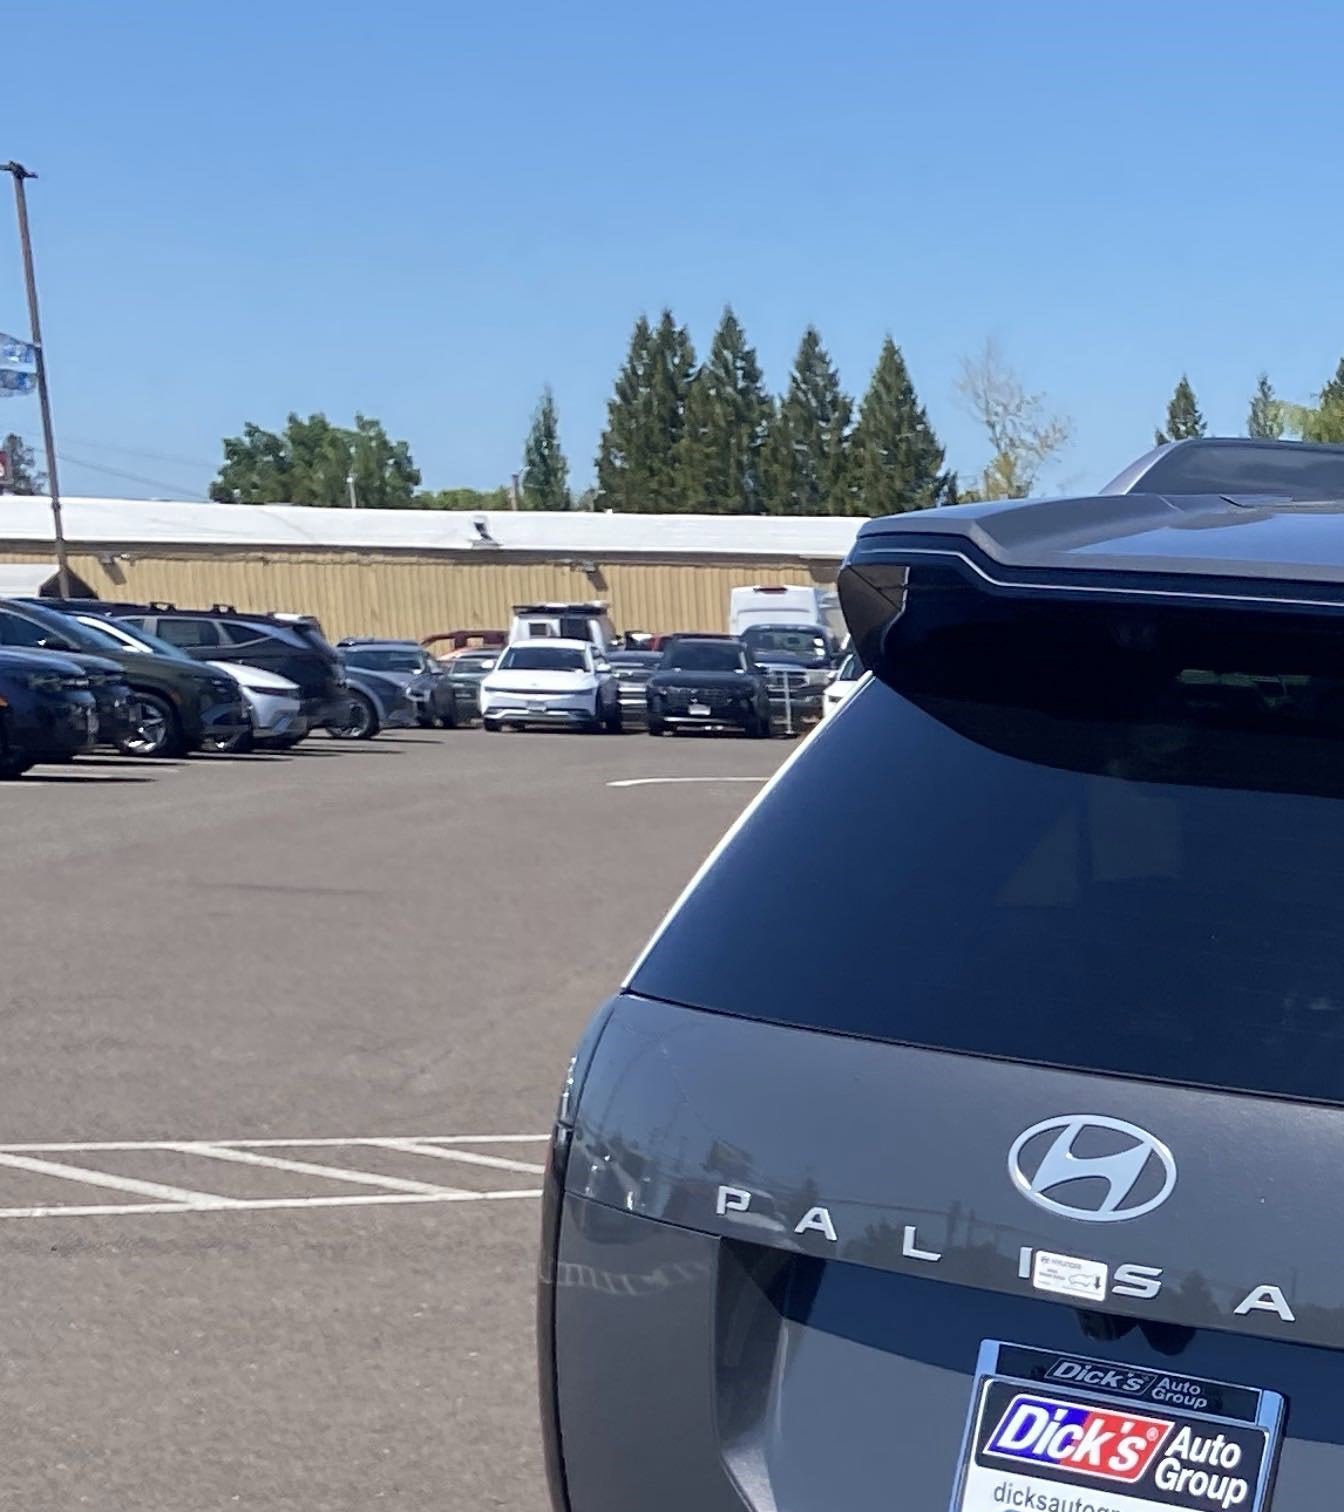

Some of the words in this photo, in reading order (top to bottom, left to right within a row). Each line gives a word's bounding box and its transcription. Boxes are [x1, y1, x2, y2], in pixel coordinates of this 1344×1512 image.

[1052, 1360, 1150, 1392] Dick's
[1157, 1377, 1201, 1396] Auto
[1152, 1387, 1208, 1410] Group
[997, 1403, 1148, 1472] Dick's
[1164, 1426, 1242, 1470] Auto
[1154, 1458, 1249, 1509] Group
